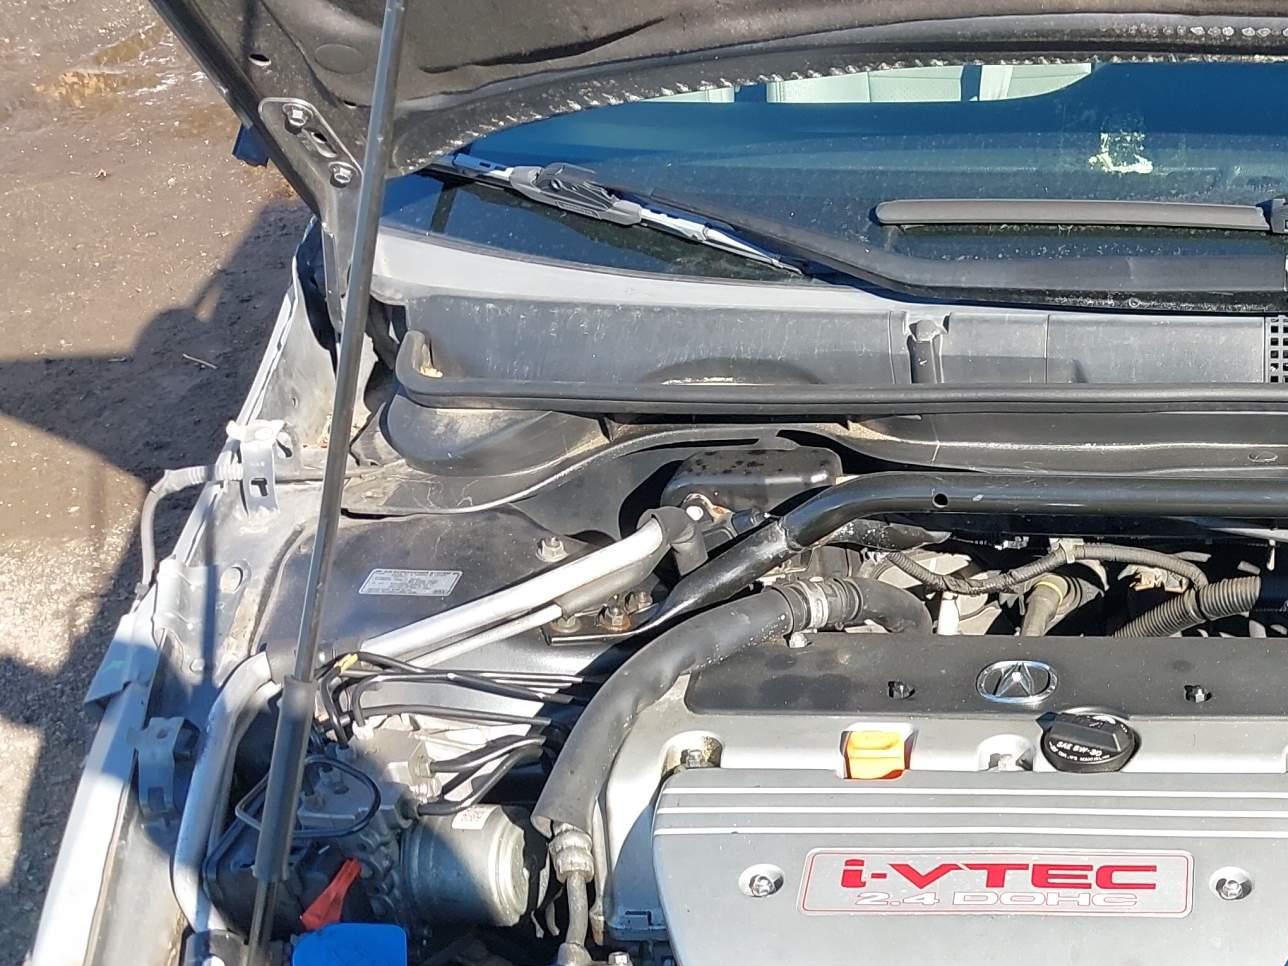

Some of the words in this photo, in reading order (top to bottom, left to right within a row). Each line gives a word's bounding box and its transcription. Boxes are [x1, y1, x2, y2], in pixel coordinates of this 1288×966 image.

[1056, 741, 1074, 751] SAE
[840, 858, 1157, 890] i-VTEC
[854, 891, 941, 906] 2.4
[951, 891, 1139, 907] DOHC
